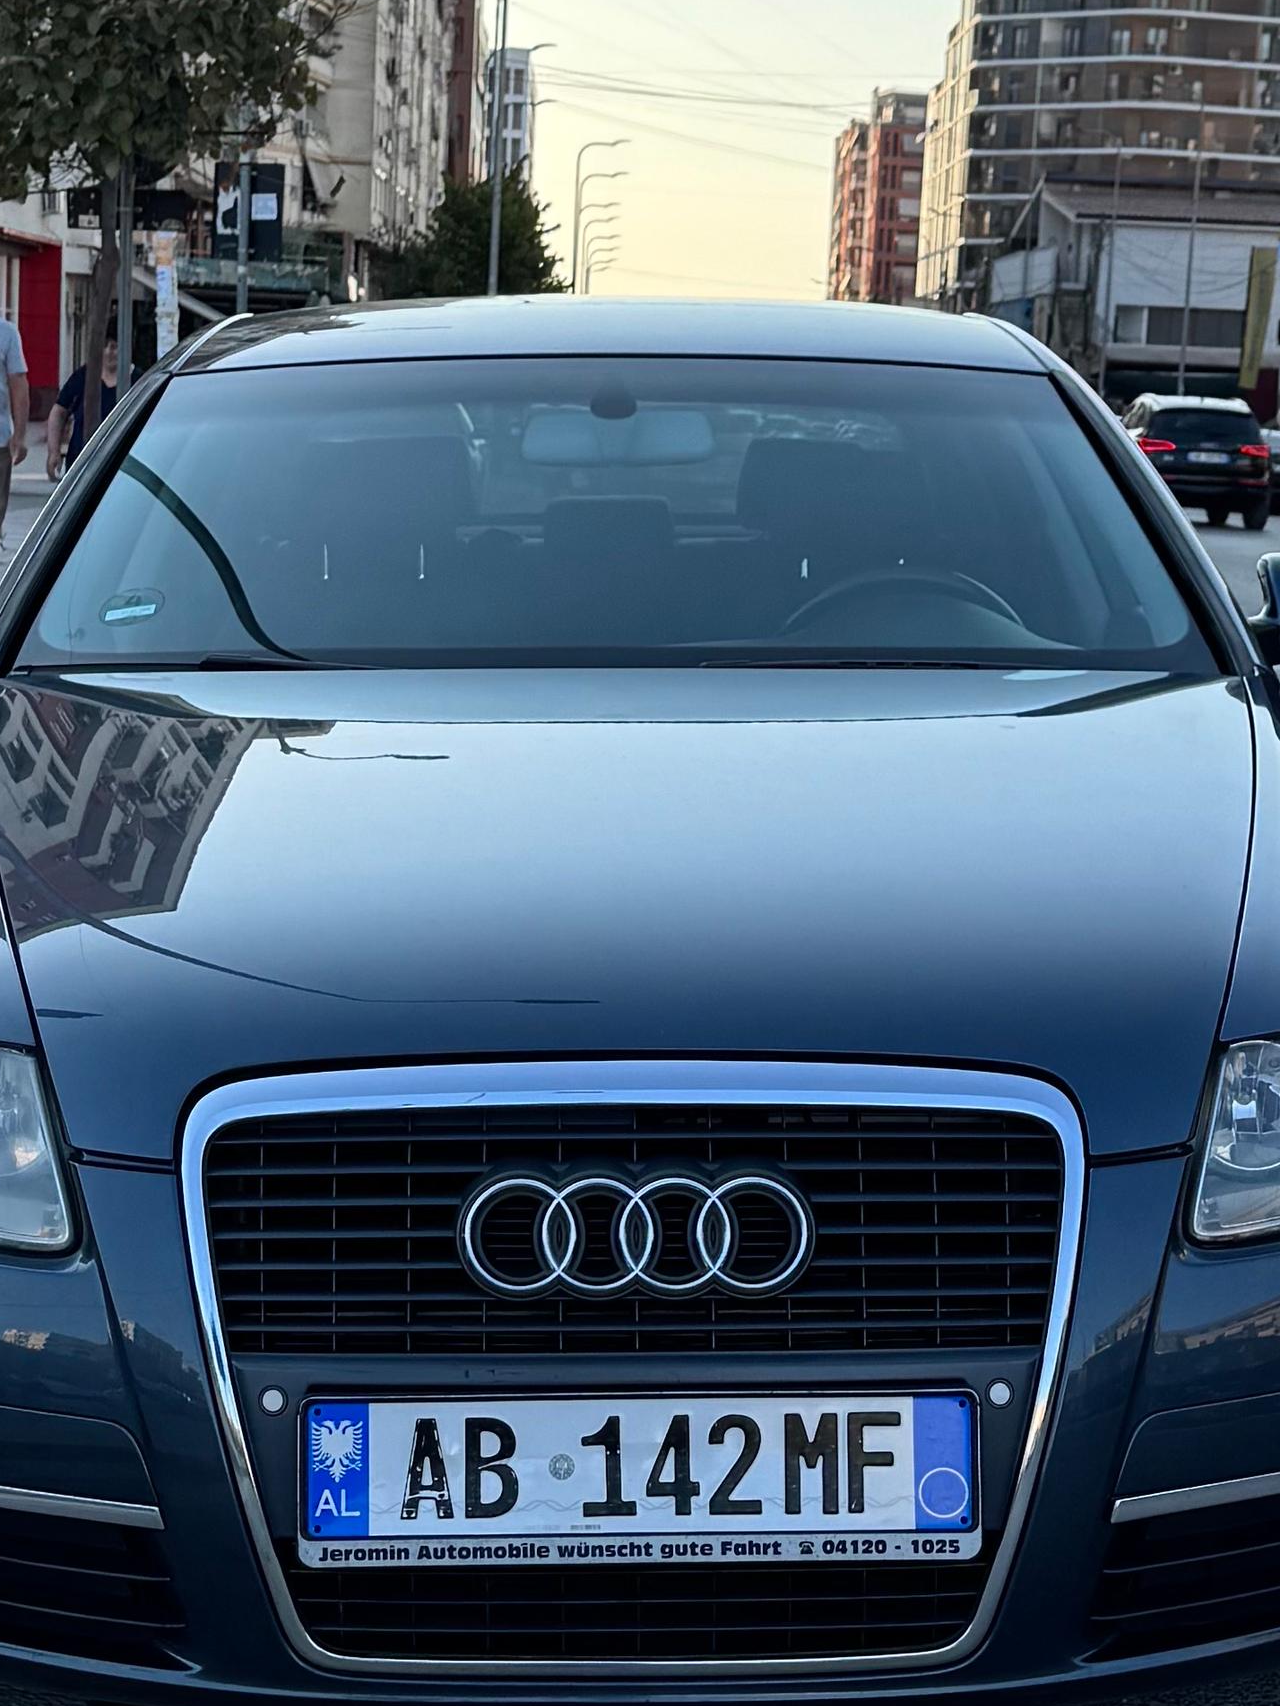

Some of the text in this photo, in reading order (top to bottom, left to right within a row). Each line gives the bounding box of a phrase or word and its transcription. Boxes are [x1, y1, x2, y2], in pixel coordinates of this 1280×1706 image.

[400, 1411, 901, 1519] AB 142 MF
[315, 1489, 361, 1517] AL
[318, 1544, 410, 1562] Jeromin
[417, 1542, 550, 1560] Automobile
[558, 1541, 653, 1558] wünscht
[660, 1541, 713, 1558] gute
[721, 1540, 782, 1556] Fahrt
[822, 1539, 888, 1554] 04120
[911, 1539, 960, 1554] 1025
